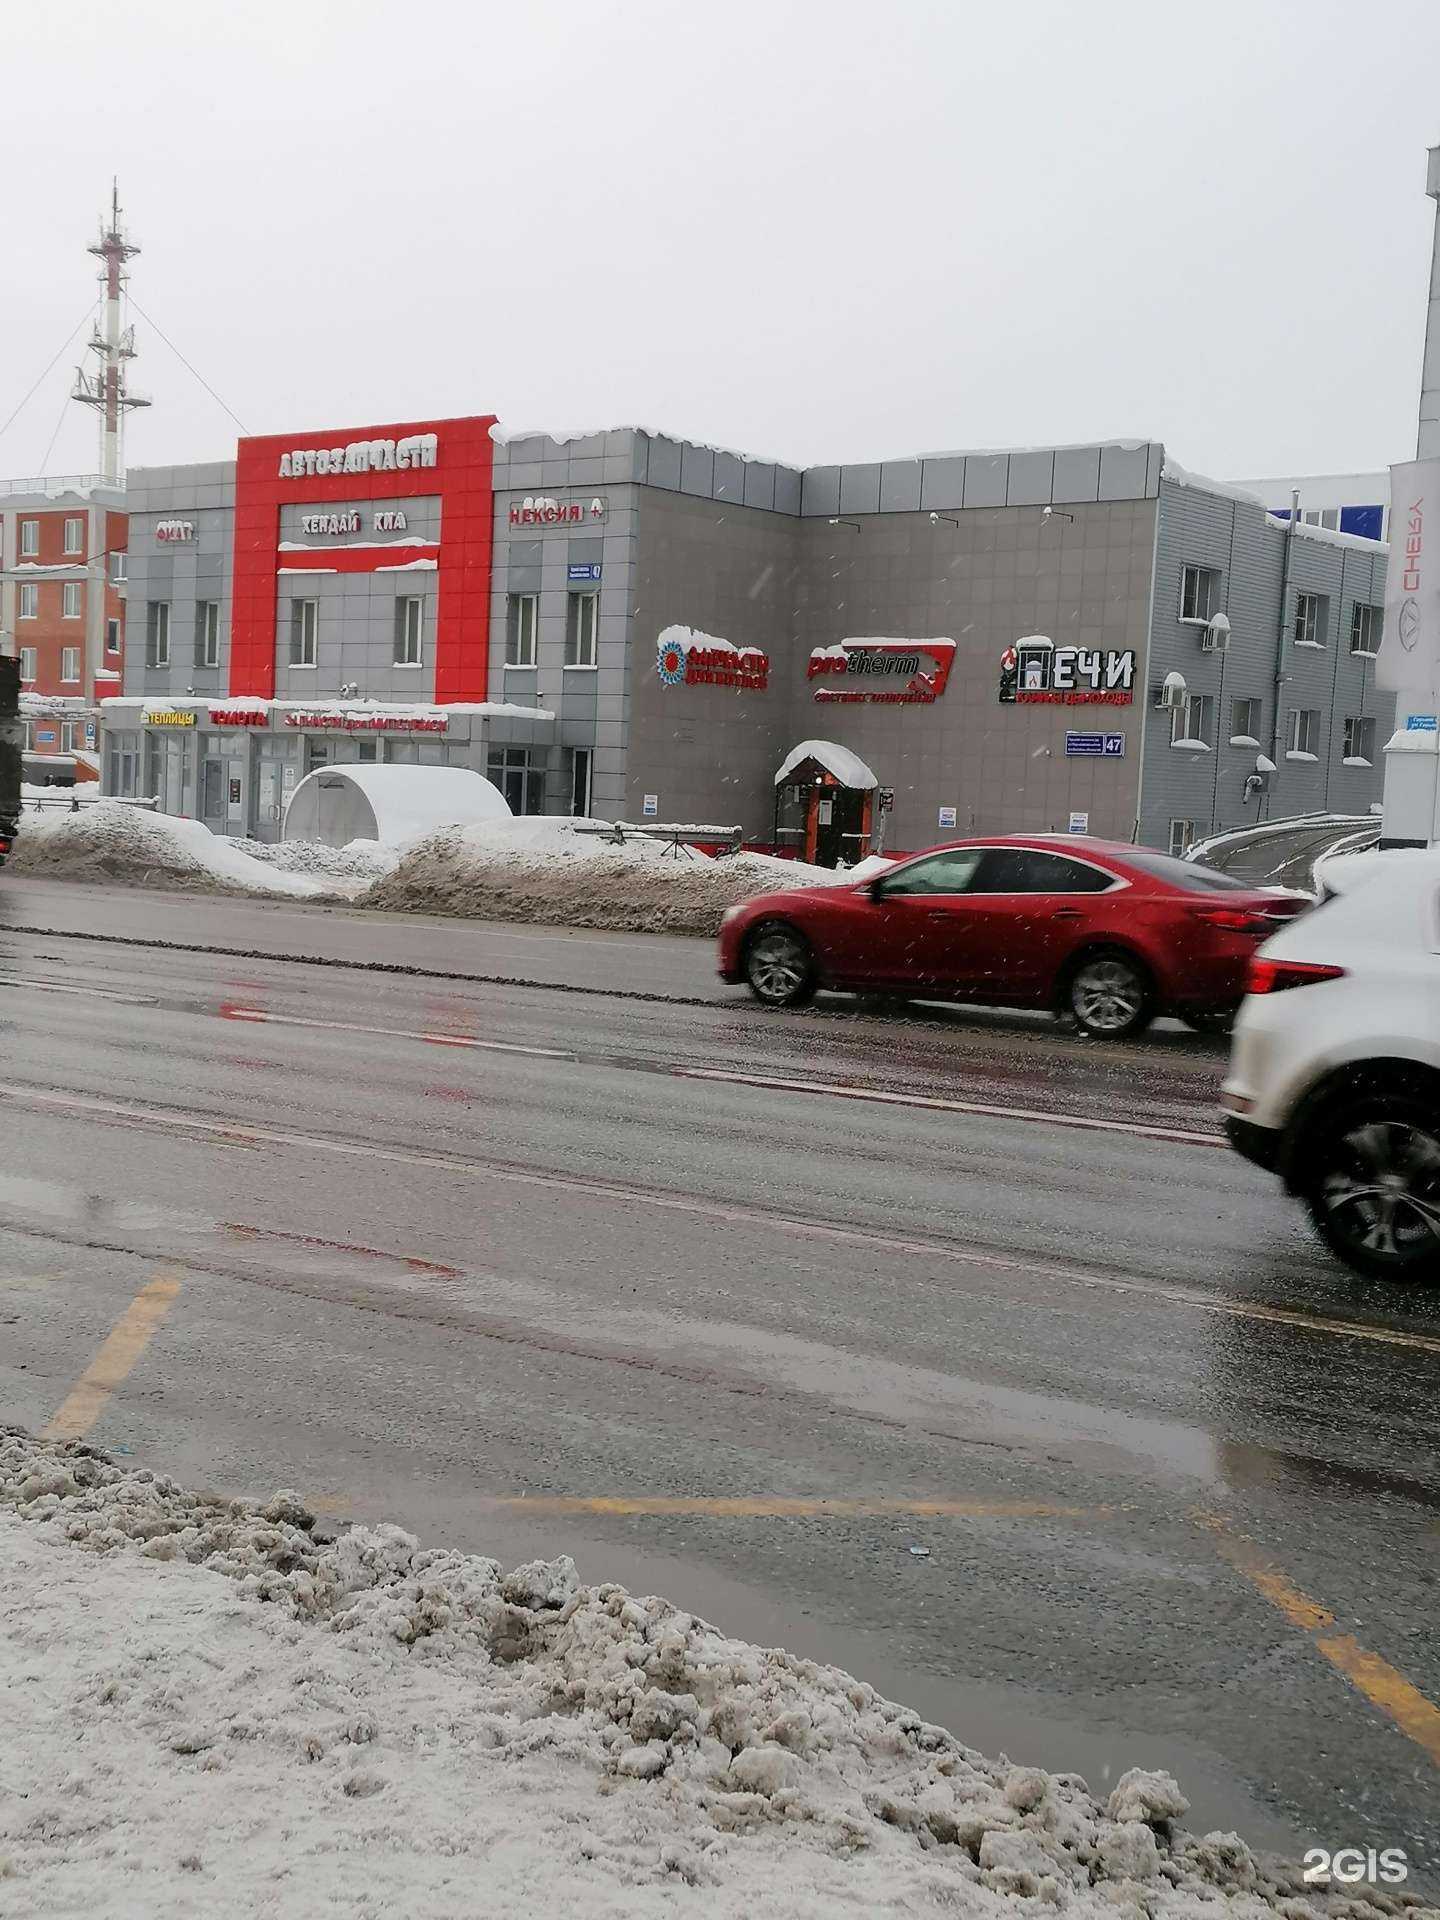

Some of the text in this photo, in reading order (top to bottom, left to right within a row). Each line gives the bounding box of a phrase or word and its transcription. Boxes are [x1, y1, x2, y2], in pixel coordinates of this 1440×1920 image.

[278, 434, 438, 478] АВТОЗАПЧАСТИ
[302, 510, 407, 535] ХЕНДАЙ КИА
[510, 503, 584, 525] НЕКСИЯ
[1403, 497, 1423, 592] CHERY
[807, 650, 919, 680] protherm
[149, 711, 194, 727] ТЕПЛИЦЫ
[1106, 738, 1121, 751] 47
